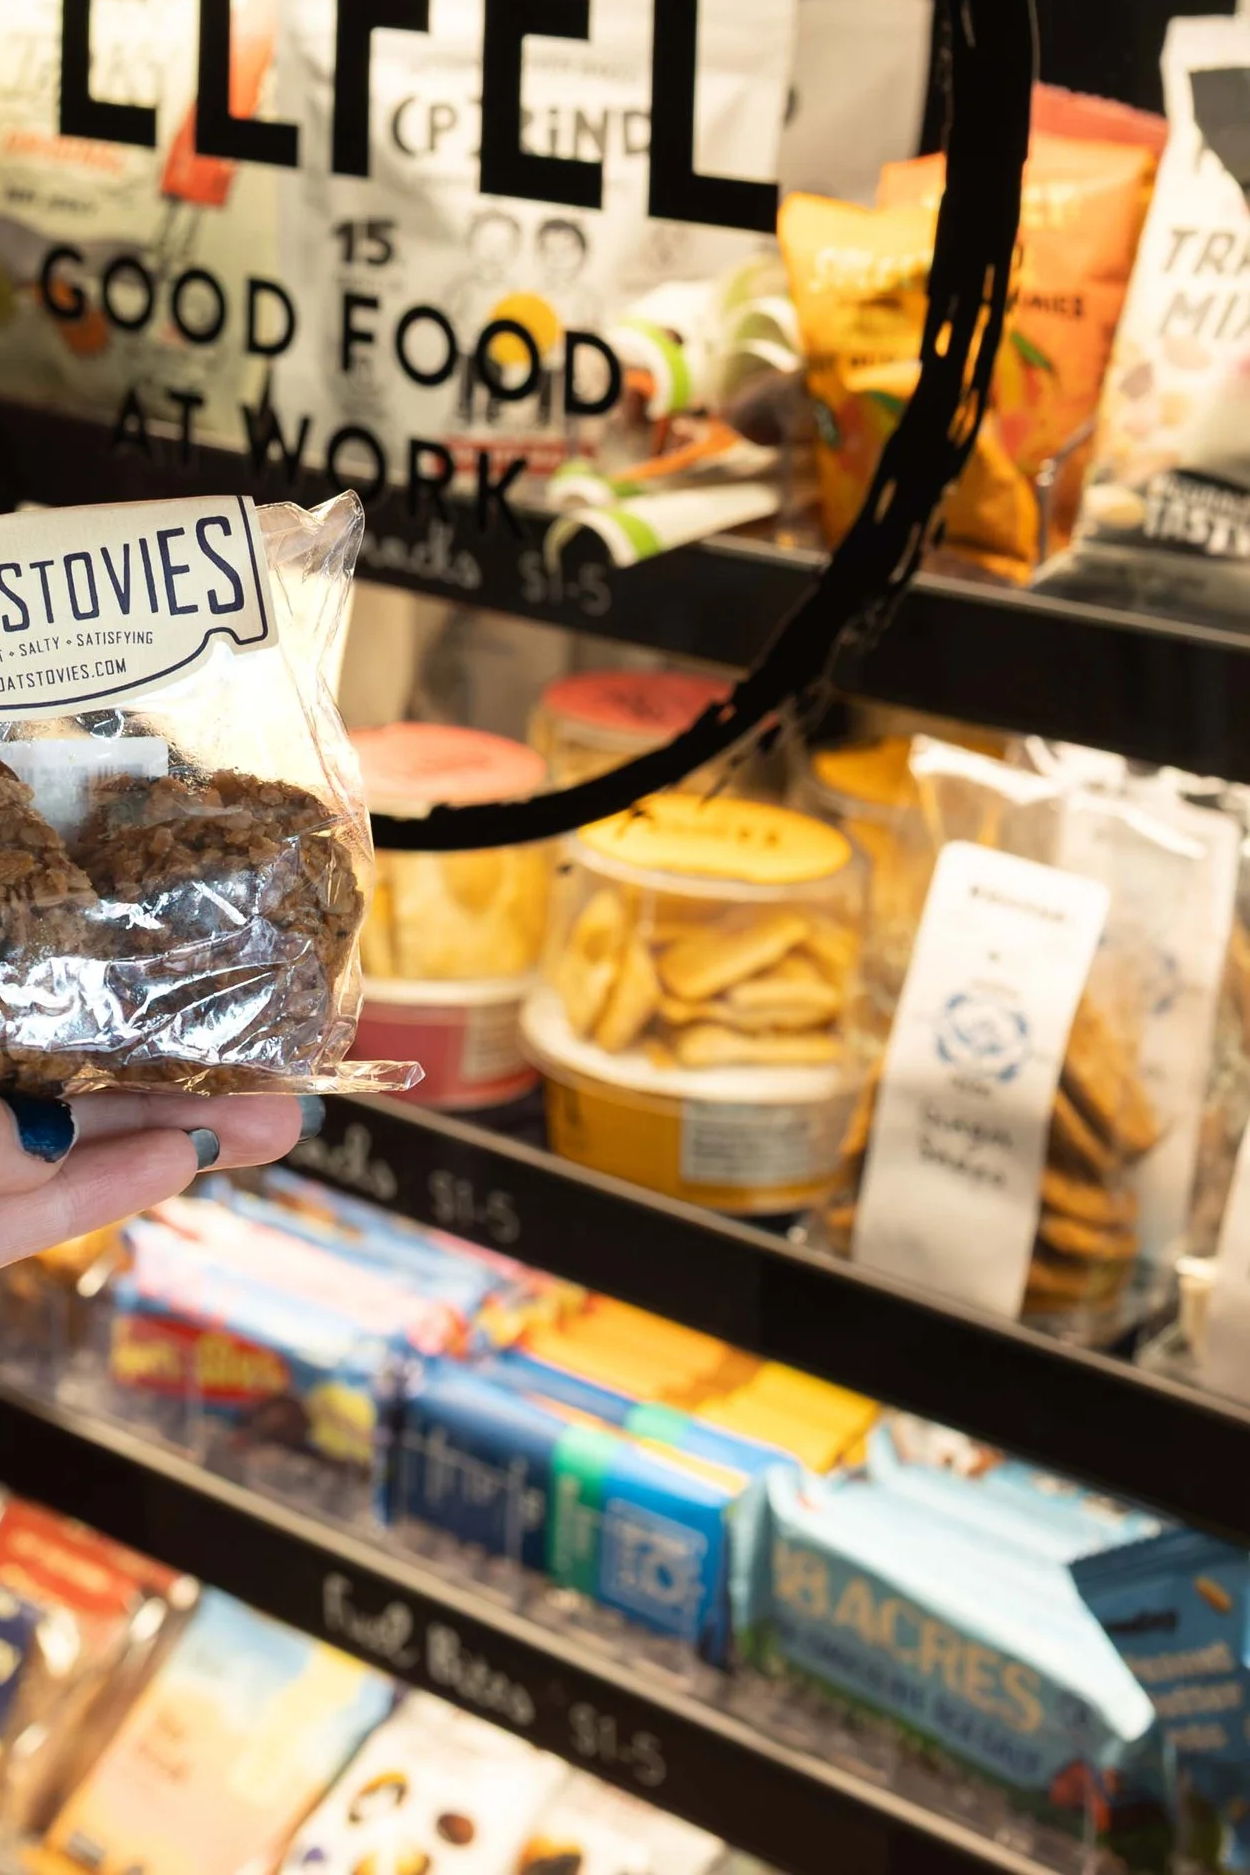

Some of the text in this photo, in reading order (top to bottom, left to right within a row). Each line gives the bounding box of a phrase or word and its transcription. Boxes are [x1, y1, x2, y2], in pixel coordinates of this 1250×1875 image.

[332, 219, 396, 267] 15
[39, 245, 623, 416] GOOD FOOD
[112, 387, 205, 462] AT
[240, 402, 528, 539] WORK
[363, 523, 482, 590] nacks
[18, 636, 60, 658] SALTY
[76, 630, 154, 648] SATISFYING
[834, 1575, 1045, 1733] ACRES
